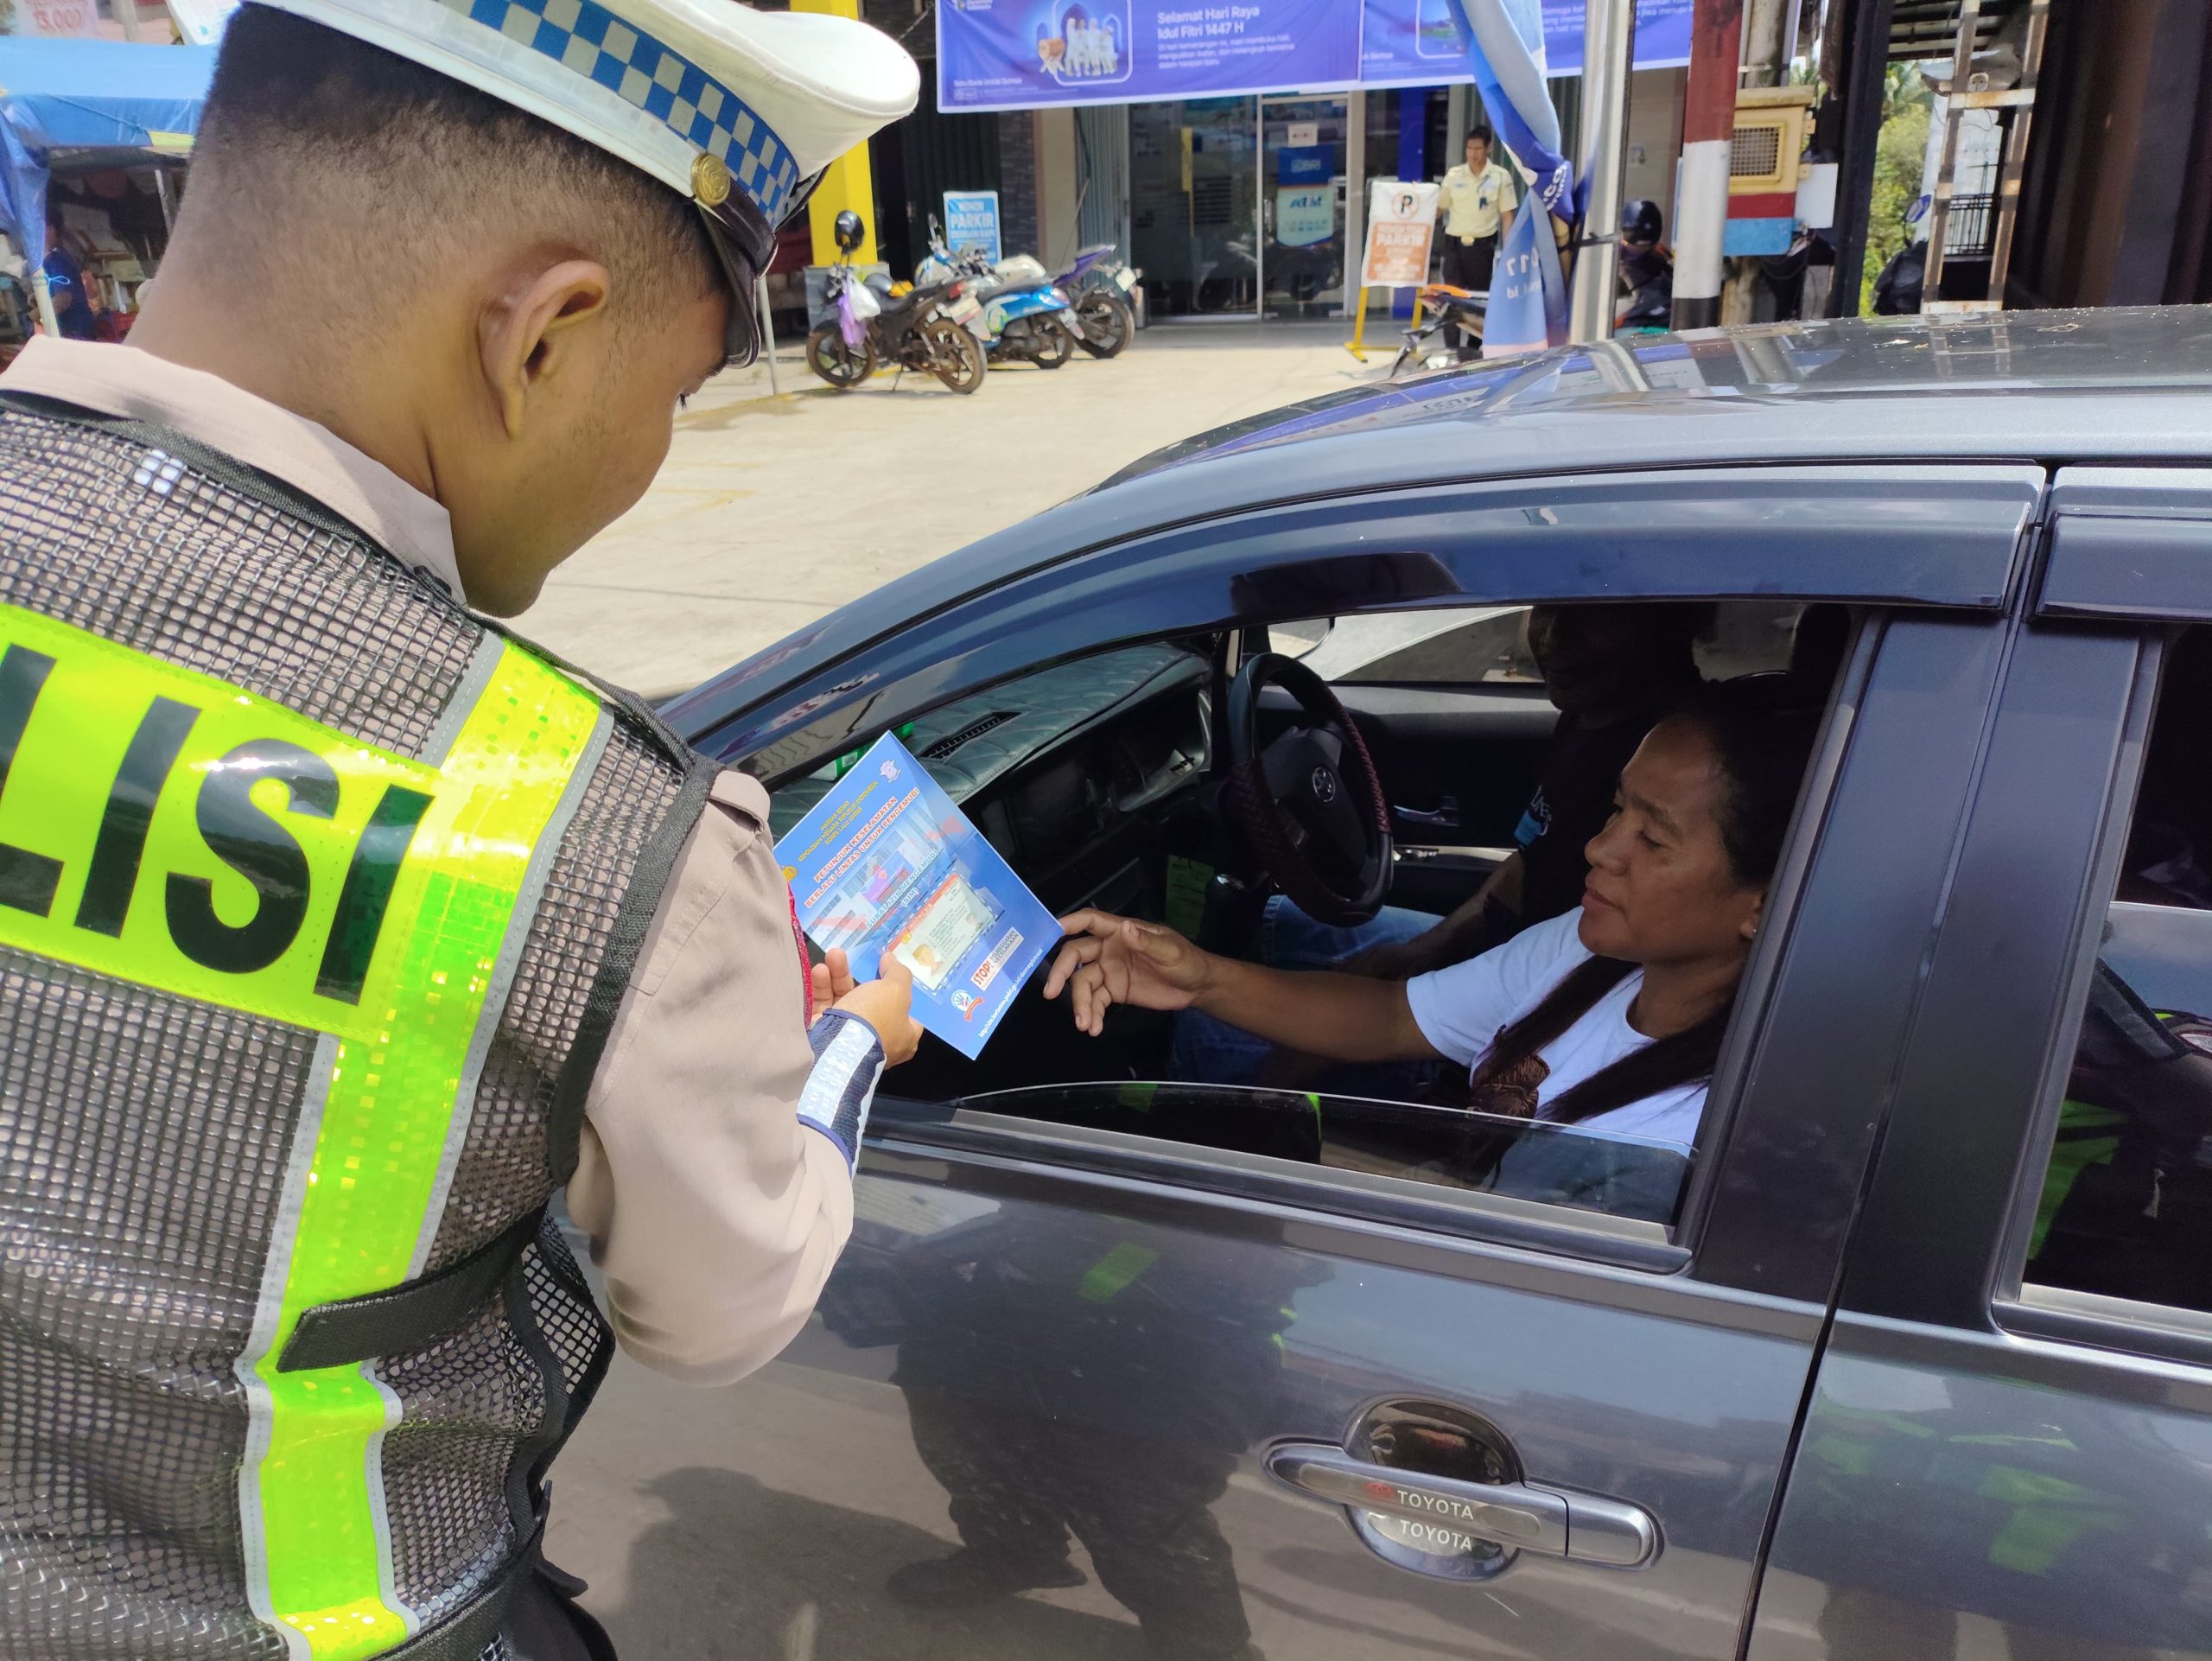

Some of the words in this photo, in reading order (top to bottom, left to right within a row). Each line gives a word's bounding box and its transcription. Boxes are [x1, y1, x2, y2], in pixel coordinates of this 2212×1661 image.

[1157, 10, 1203, 24] Selamat
[1205, 7, 1230, 20] Hari
[1231, 6, 1260, 20] Raya
[1157, 27, 1179, 40] Idul
[1181, 24, 1203, 38] Fitri
[1205, 22, 1232, 35] 1447
[1234, 22, 1244, 34] H
[950, 213, 995, 230] PARKIR
[804, 874, 837, 908] BERLALU
[834, 849, 861, 877] LINTAS
[859, 825, 884, 851] UNTUK
[881, 786, 920, 828] PENGEMUDI
[813, 843, 852, 882] PETUNJUK
[849, 795, 898, 846] KESELAMATAN
[865, 902, 889, 928] SURAT
[886, 888, 902, 906] IZIN
[899, 848, 939, 891] MENGEMUDI
[899, 885, 920, 908] (SIM)
[906, 901, 932, 930] INDONESIA
[972, 959, 995, 985] STOP!
[1397, 1490, 1474, 1520] TOYOTA
[1400, 1519, 1472, 1552] TOYOTA
